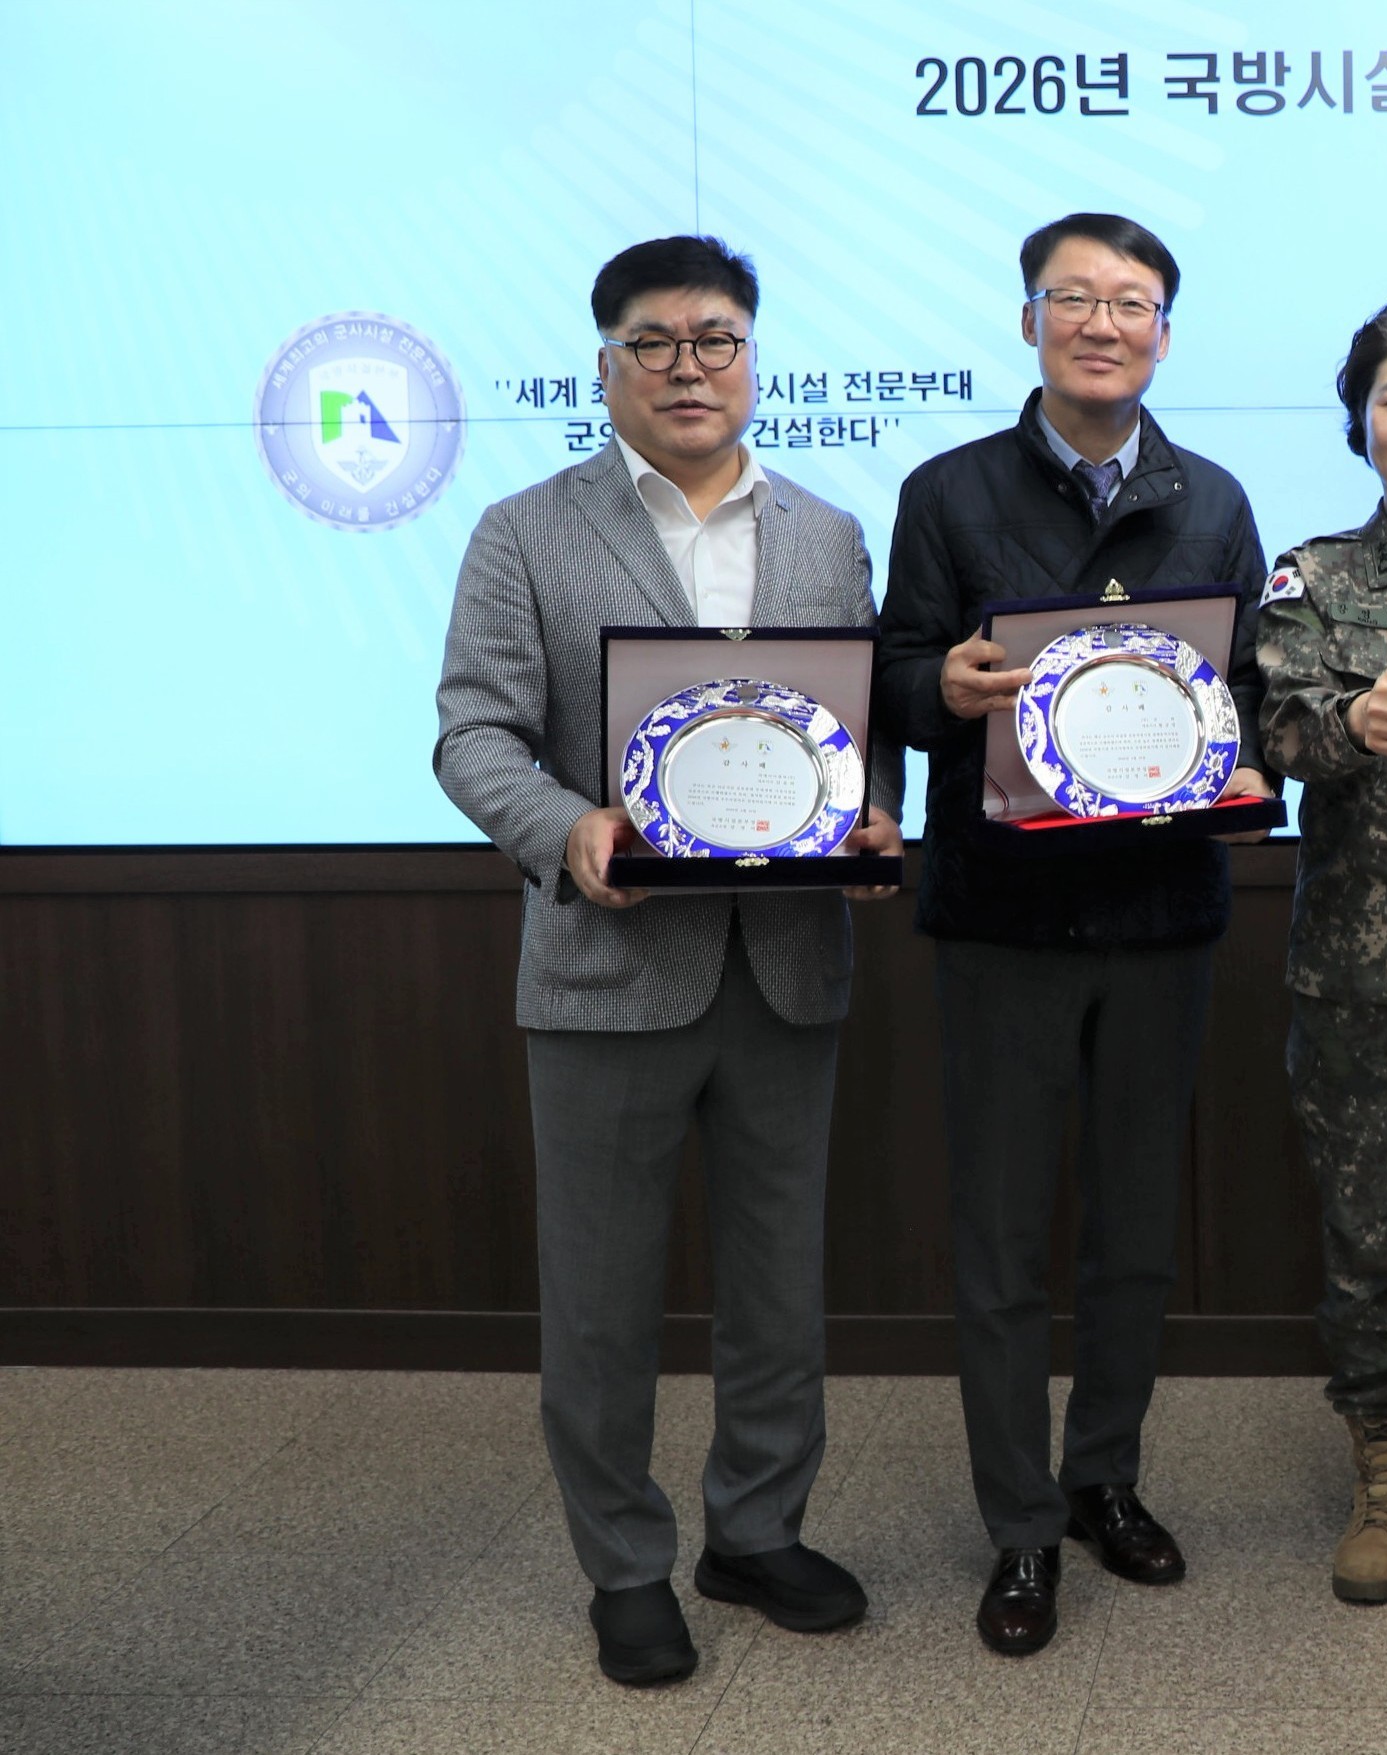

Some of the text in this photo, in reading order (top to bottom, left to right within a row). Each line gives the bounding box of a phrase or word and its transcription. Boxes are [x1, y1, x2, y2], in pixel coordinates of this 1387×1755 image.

[915, 52, 1130, 117] 2026년
[333, 323, 394, 344] 군사시설
[398, 336, 446, 387] 전문부대
[756, 371, 829, 405] 시설
[843, 369, 973, 402] 전문부대
